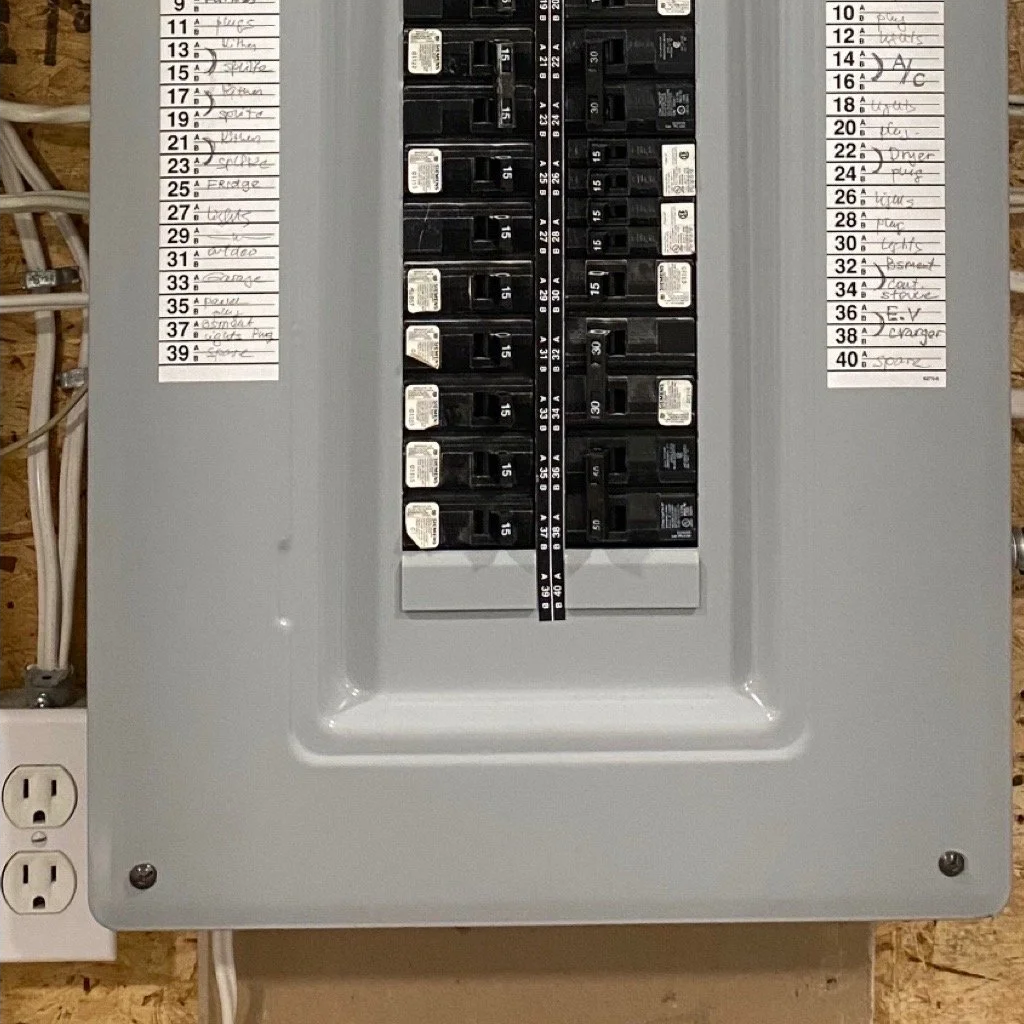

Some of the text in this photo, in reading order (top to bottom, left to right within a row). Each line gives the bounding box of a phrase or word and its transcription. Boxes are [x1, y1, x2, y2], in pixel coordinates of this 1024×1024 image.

[832, 4, 855, 21] 10
[167, 19, 187, 35] 11
[833, 27, 855, 44] 12
[167, 41, 189, 58] 13
[501, 48, 510, 61] 15
[833, 51, 855, 67] 14
[167, 64, 189, 81] 15
[833, 73, 855, 90] 16
[167, 88, 190, 105] 17
[833, 96, 855, 113] 18
[167, 111, 189, 128] 19
[501, 106, 511, 120] 15
[834, 119, 856, 136] 20
[167, 134, 188, 151] 21
[834, 142, 857, 159] 22
[592, 150, 601, 162] 15
[167, 157, 190, 174] 23
[502, 166, 513, 180] 15
[834, 165, 857, 182] 24
[167, 180, 190, 198] 25
[592, 179, 602, 191] 15
[835, 188, 857, 205] 26
[167, 204, 190, 221] 27
[592, 210, 601, 221] 15
[835, 211, 857, 228] 28
[167, 227, 190, 244] 29
[501, 226, 511, 239] 15
[593, 239, 602, 251] 15
[835, 235, 857, 251] 30
[167, 251, 187, 267] 31
[835, 258, 857, 274] 32
[167, 274, 189, 291] 33
[590, 282, 600, 296] 15
[835, 281, 858, 298] 34
[501, 286, 511, 300] 15
[167, 298, 190, 314] 35
[835, 304, 858, 321] 36
[167, 321, 190, 338] 37
[835, 327, 858, 344] 38
[167, 344, 189, 362] 39
[501, 345, 511, 358] 15
[591, 341, 601, 356] 30
[836, 350, 859, 368] 40
[500, 403, 511, 417] 15
[590, 400, 600, 415] 30
[501, 463, 512, 477] 15
[501, 522, 512, 536] 15
